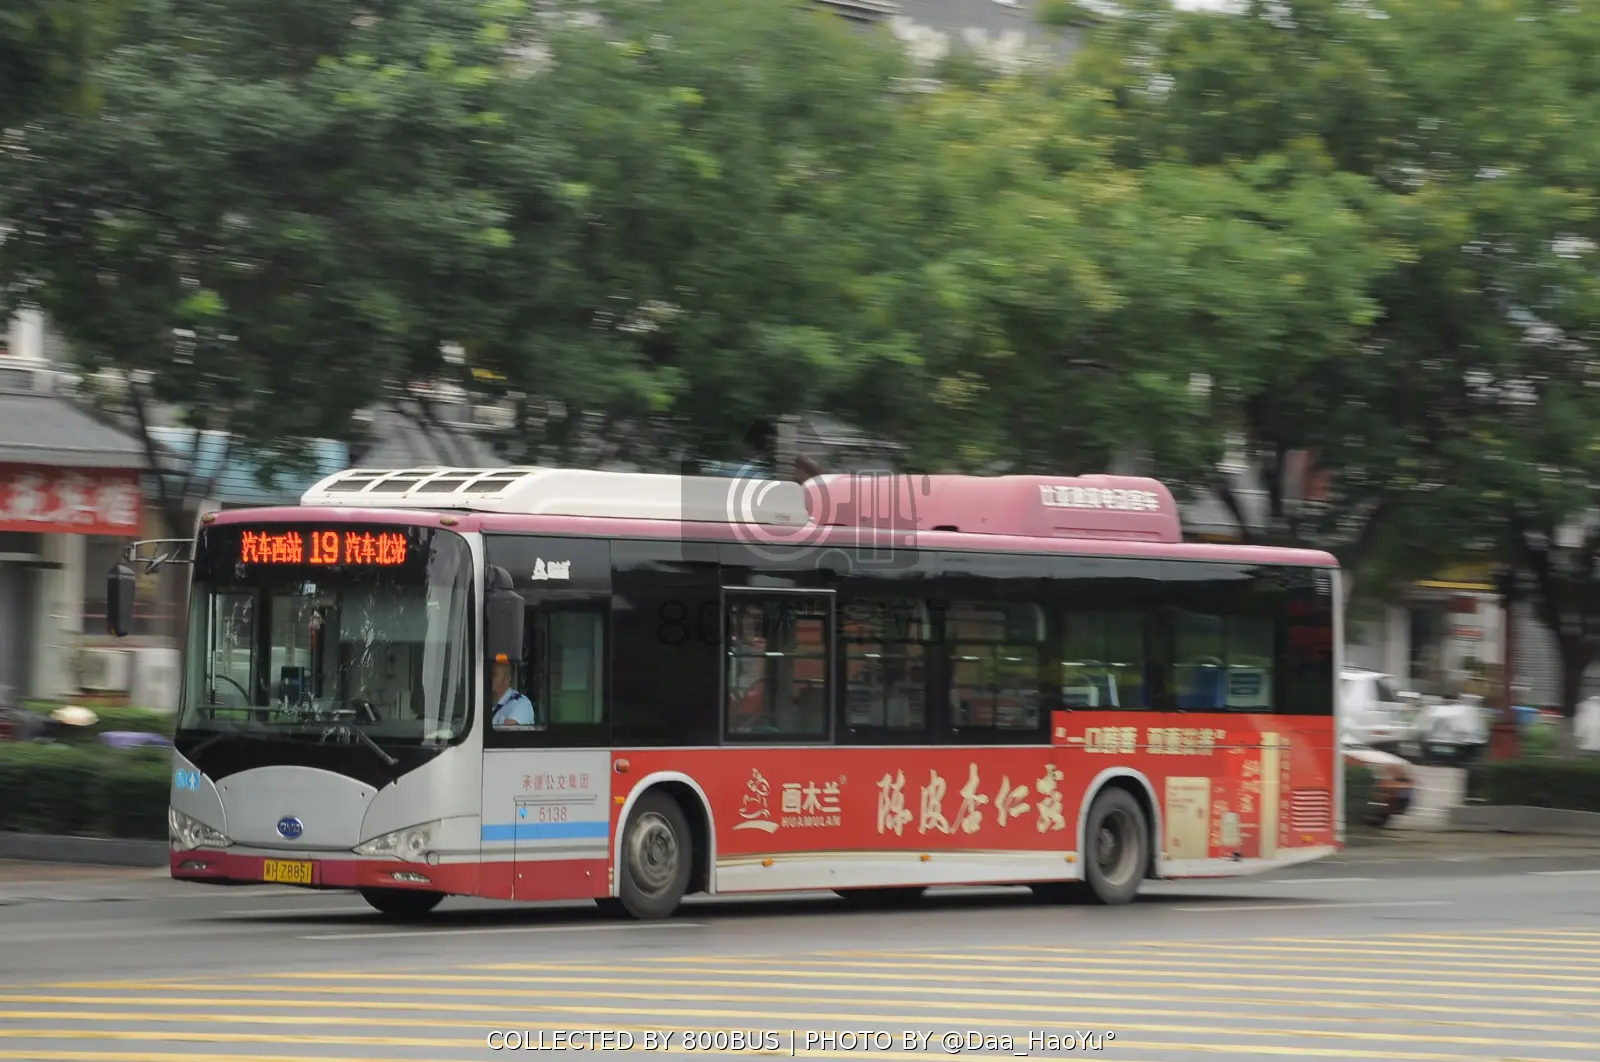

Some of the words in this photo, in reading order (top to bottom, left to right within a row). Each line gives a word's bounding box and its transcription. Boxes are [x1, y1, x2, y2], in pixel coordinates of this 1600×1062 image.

[242, 531, 303, 564] 汽车西站
[310, 531, 339, 564] 19
[346, 532, 407, 565] 汽车北站
[539, 806, 567, 822] 5138
